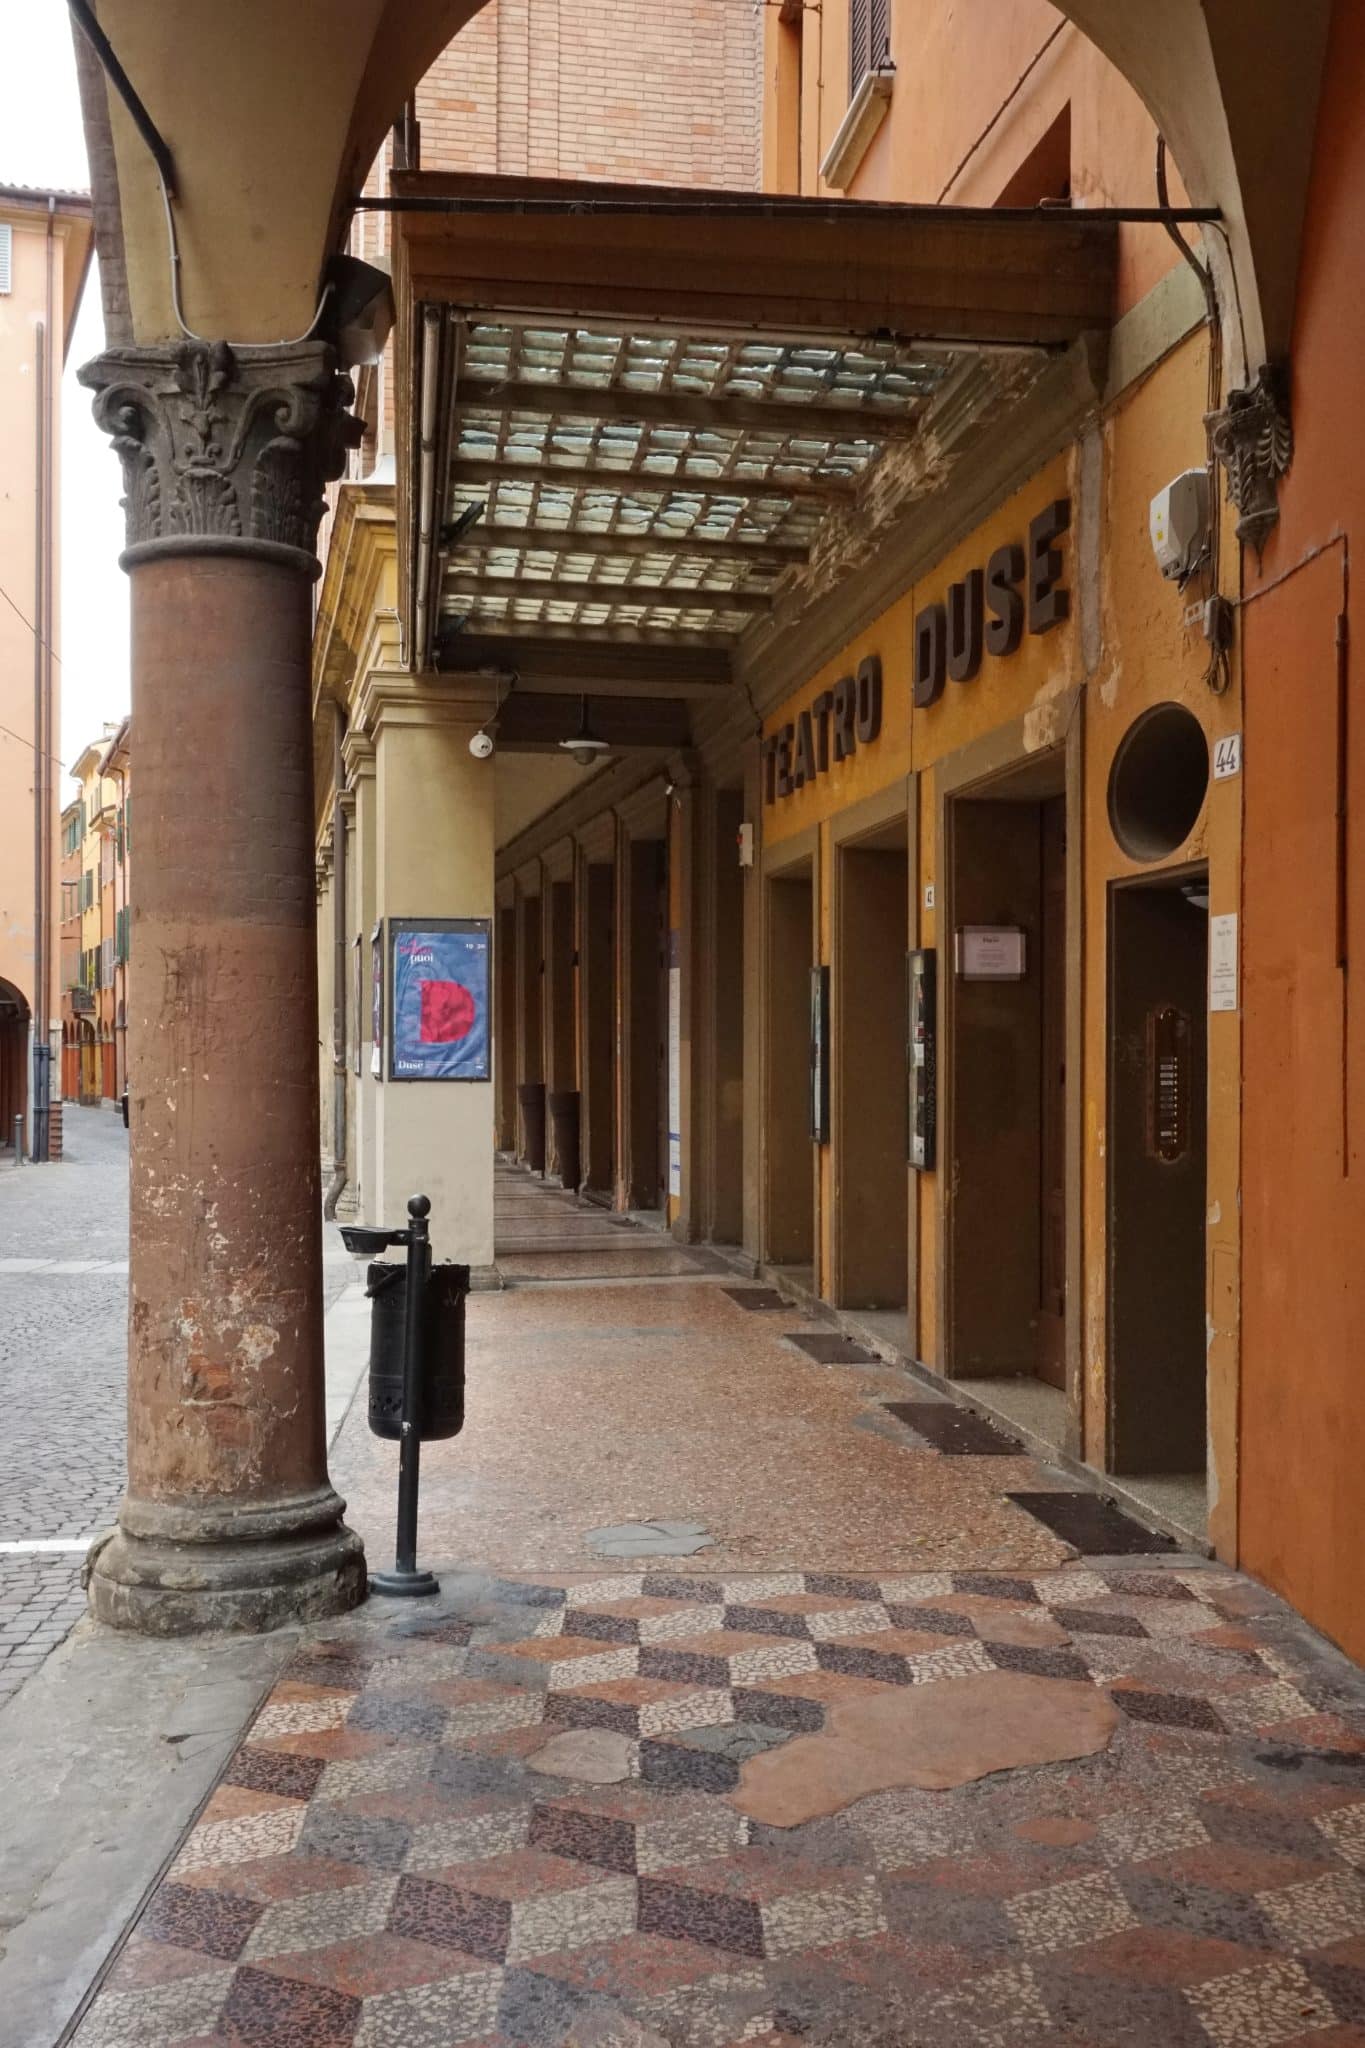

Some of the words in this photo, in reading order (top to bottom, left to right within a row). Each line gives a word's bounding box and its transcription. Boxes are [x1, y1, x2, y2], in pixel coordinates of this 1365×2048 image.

[761, 655, 883, 805] TEATRO
[913, 497, 1072, 709] DUSE
[1216, 740, 1236, 772] 44
[398, 1060, 424, 1070] Duse
